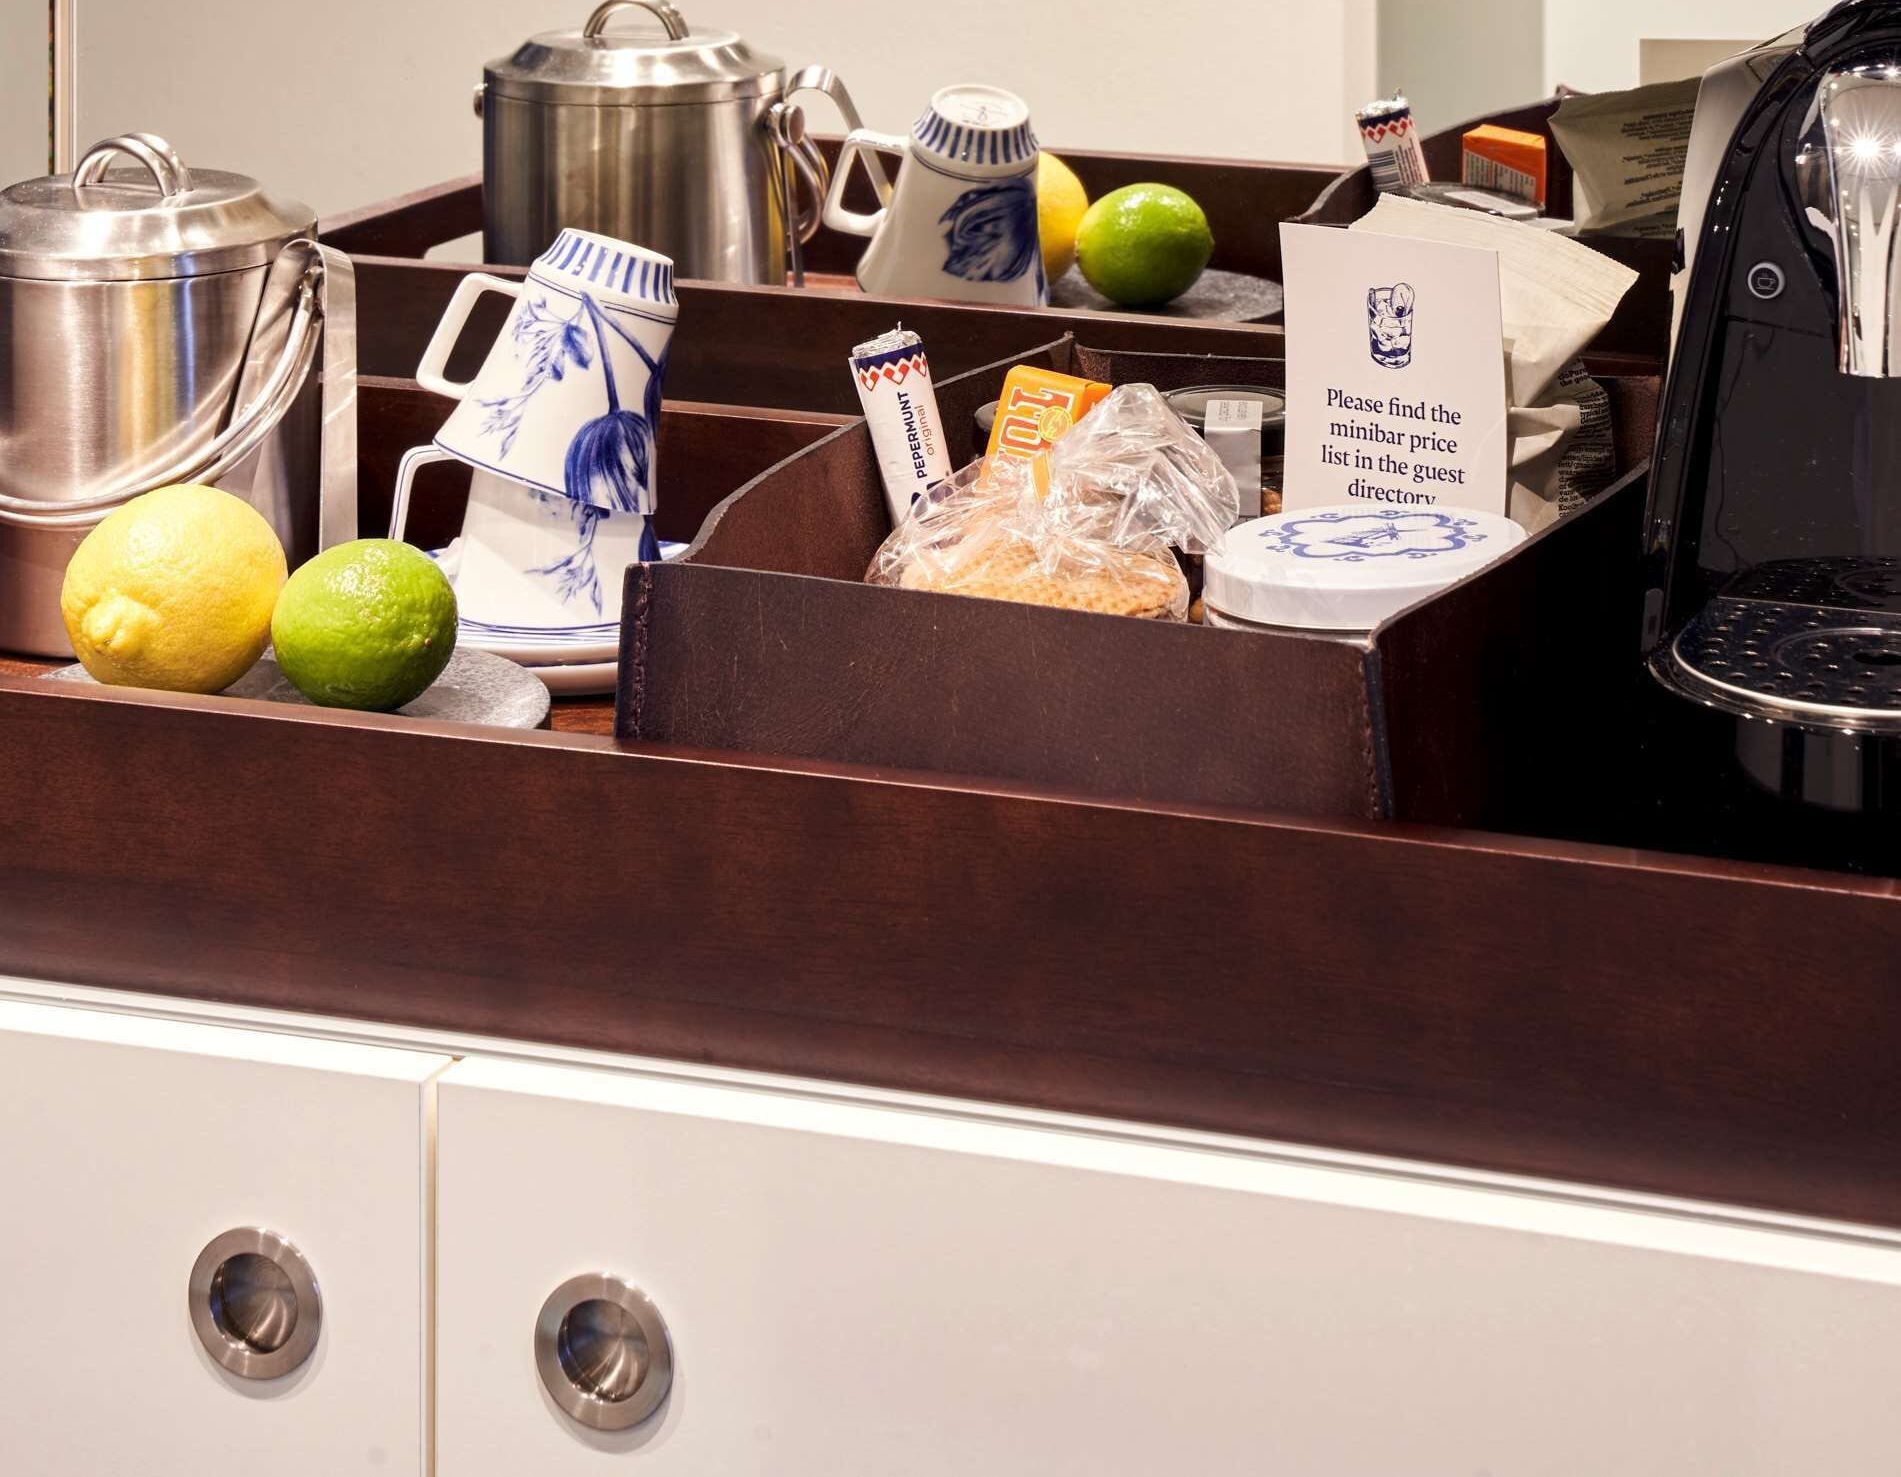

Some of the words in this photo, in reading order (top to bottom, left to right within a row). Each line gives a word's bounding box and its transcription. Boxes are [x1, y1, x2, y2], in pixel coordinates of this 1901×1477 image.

[1327, 388, 1384, 414] Please
[1388, 397, 1425, 420] find
[1431, 404, 1462, 425] the
[897, 392, 928, 479] PEPERMUNT
[914, 405, 935, 456] original
[1330, 419, 1405, 446] minibar
[1410, 431, 1458, 453] price
[1321, 444, 1350, 466] list
[1354, 449, 1373, 470] in
[1378, 454, 1408, 475] the
[1412, 463, 1466, 484] guest
[1348, 478, 1437, 506] directory
